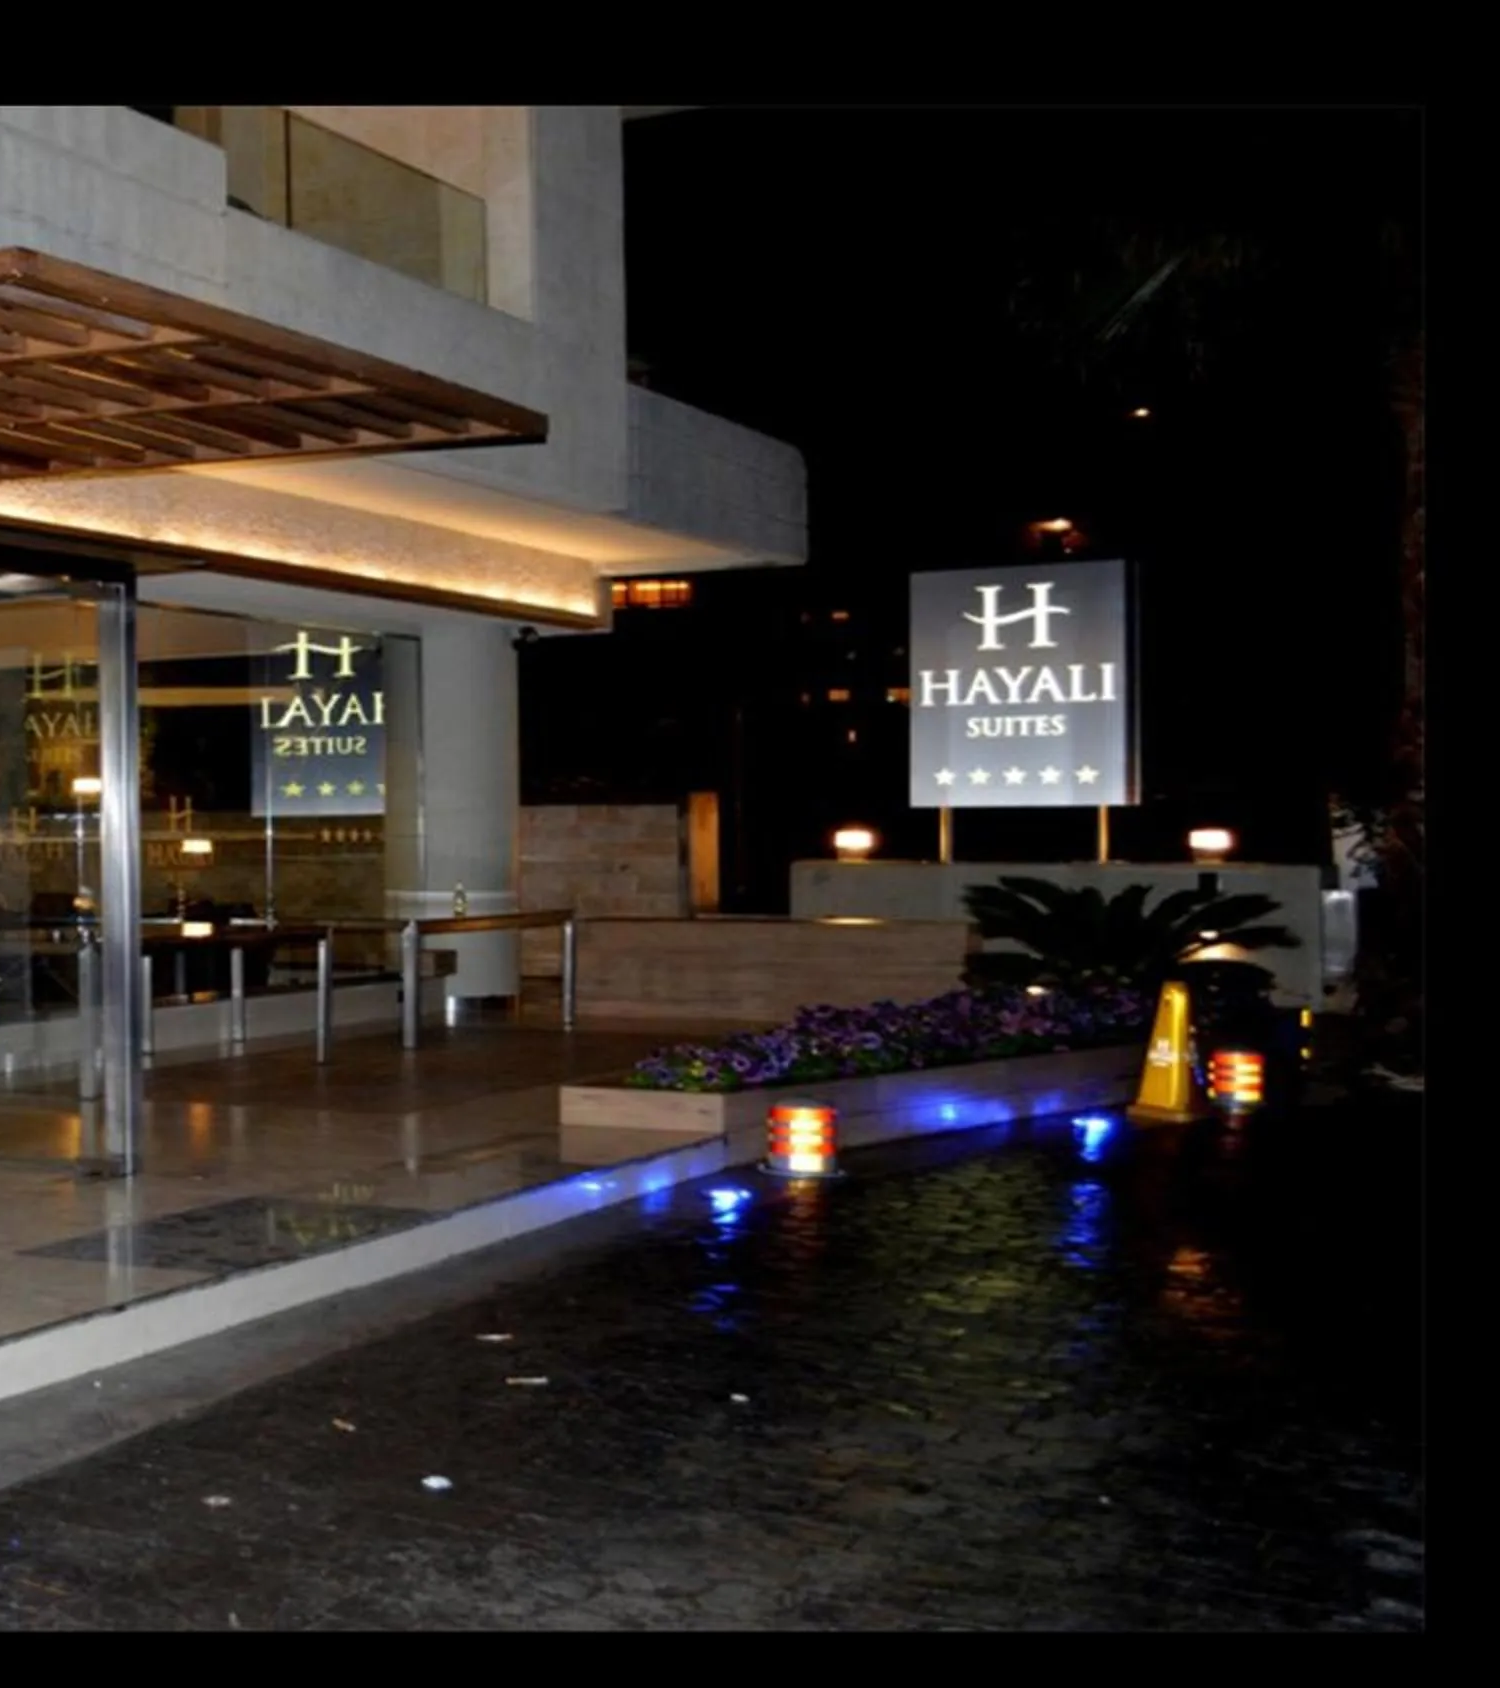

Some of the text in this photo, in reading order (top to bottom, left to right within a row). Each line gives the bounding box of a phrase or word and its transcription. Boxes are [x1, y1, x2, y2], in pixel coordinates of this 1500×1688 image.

[962, 582, 1071, 650] H
[919, 662, 1117, 707] HAYALI
[966, 714, 1067, 738] SUITES
